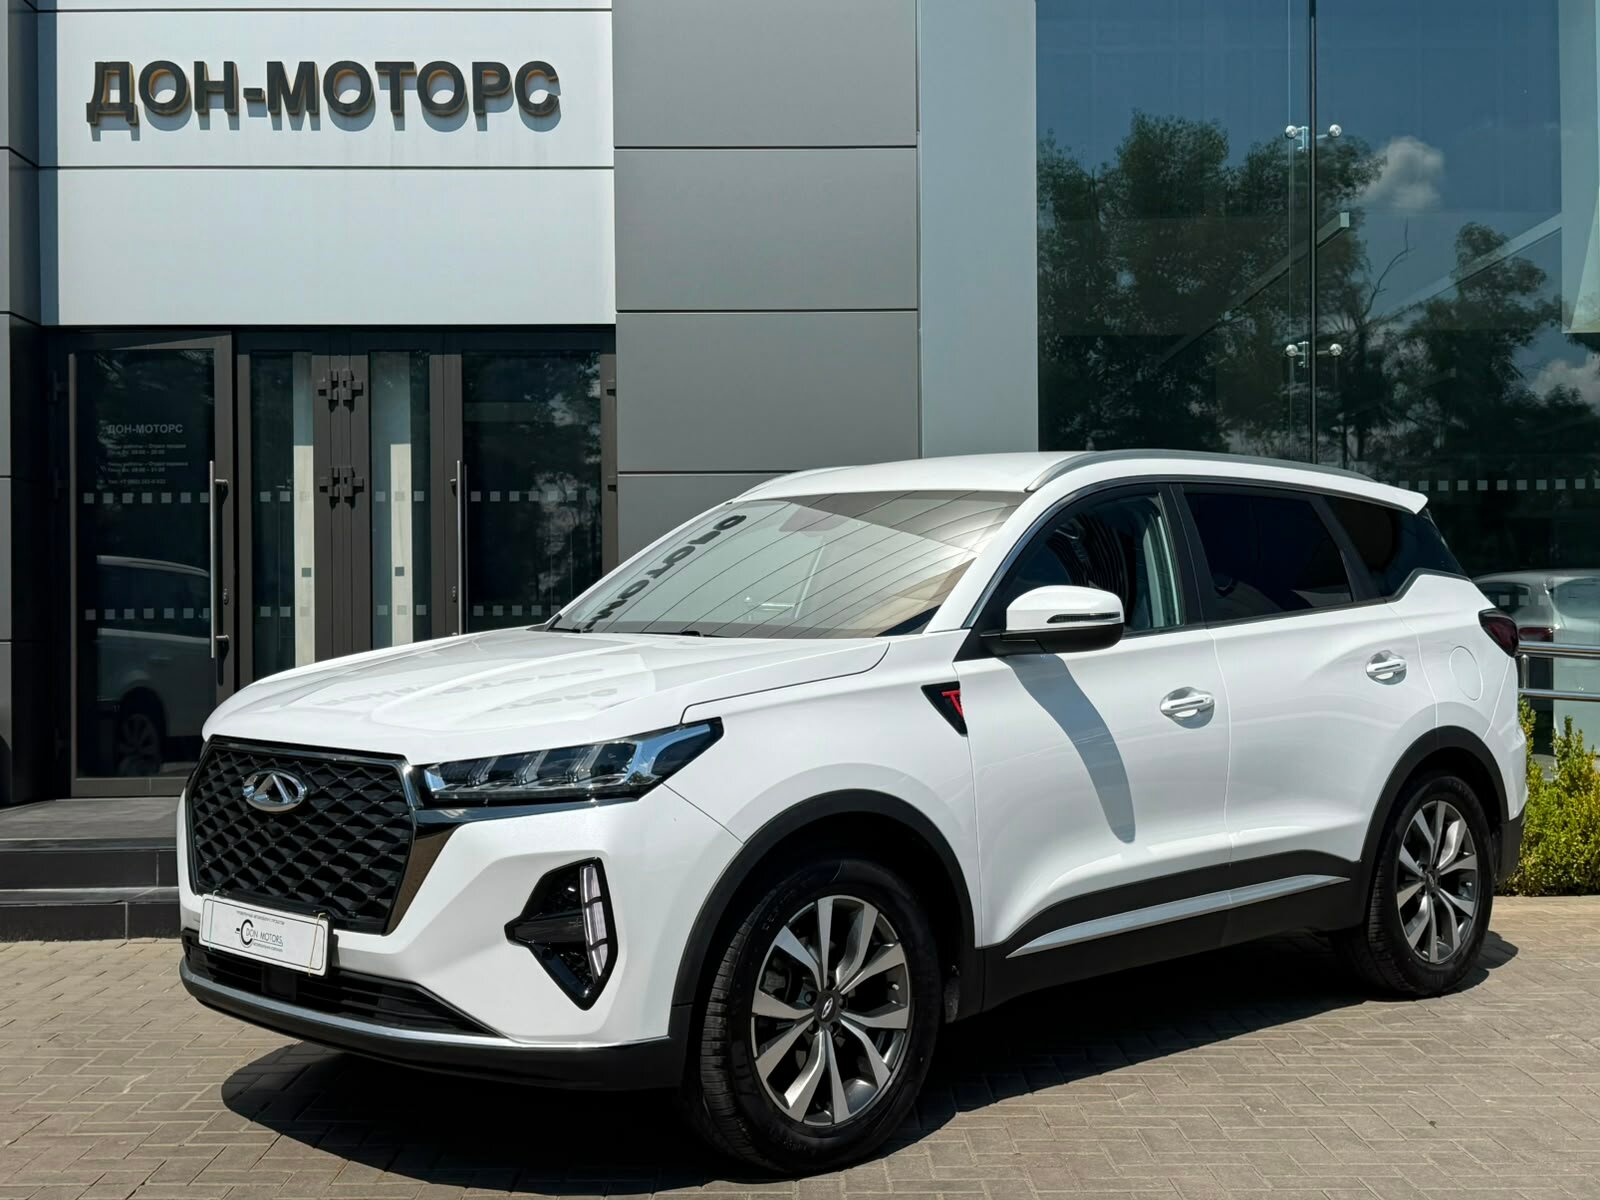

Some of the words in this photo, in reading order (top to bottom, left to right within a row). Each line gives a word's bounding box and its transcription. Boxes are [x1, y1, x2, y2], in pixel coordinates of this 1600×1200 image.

[86, 60, 561, 122] ДОН-МОТОРС
[107, 423, 184, 435] ДОН-МОТОРС
[260, 931, 283, 944] MOTORS
